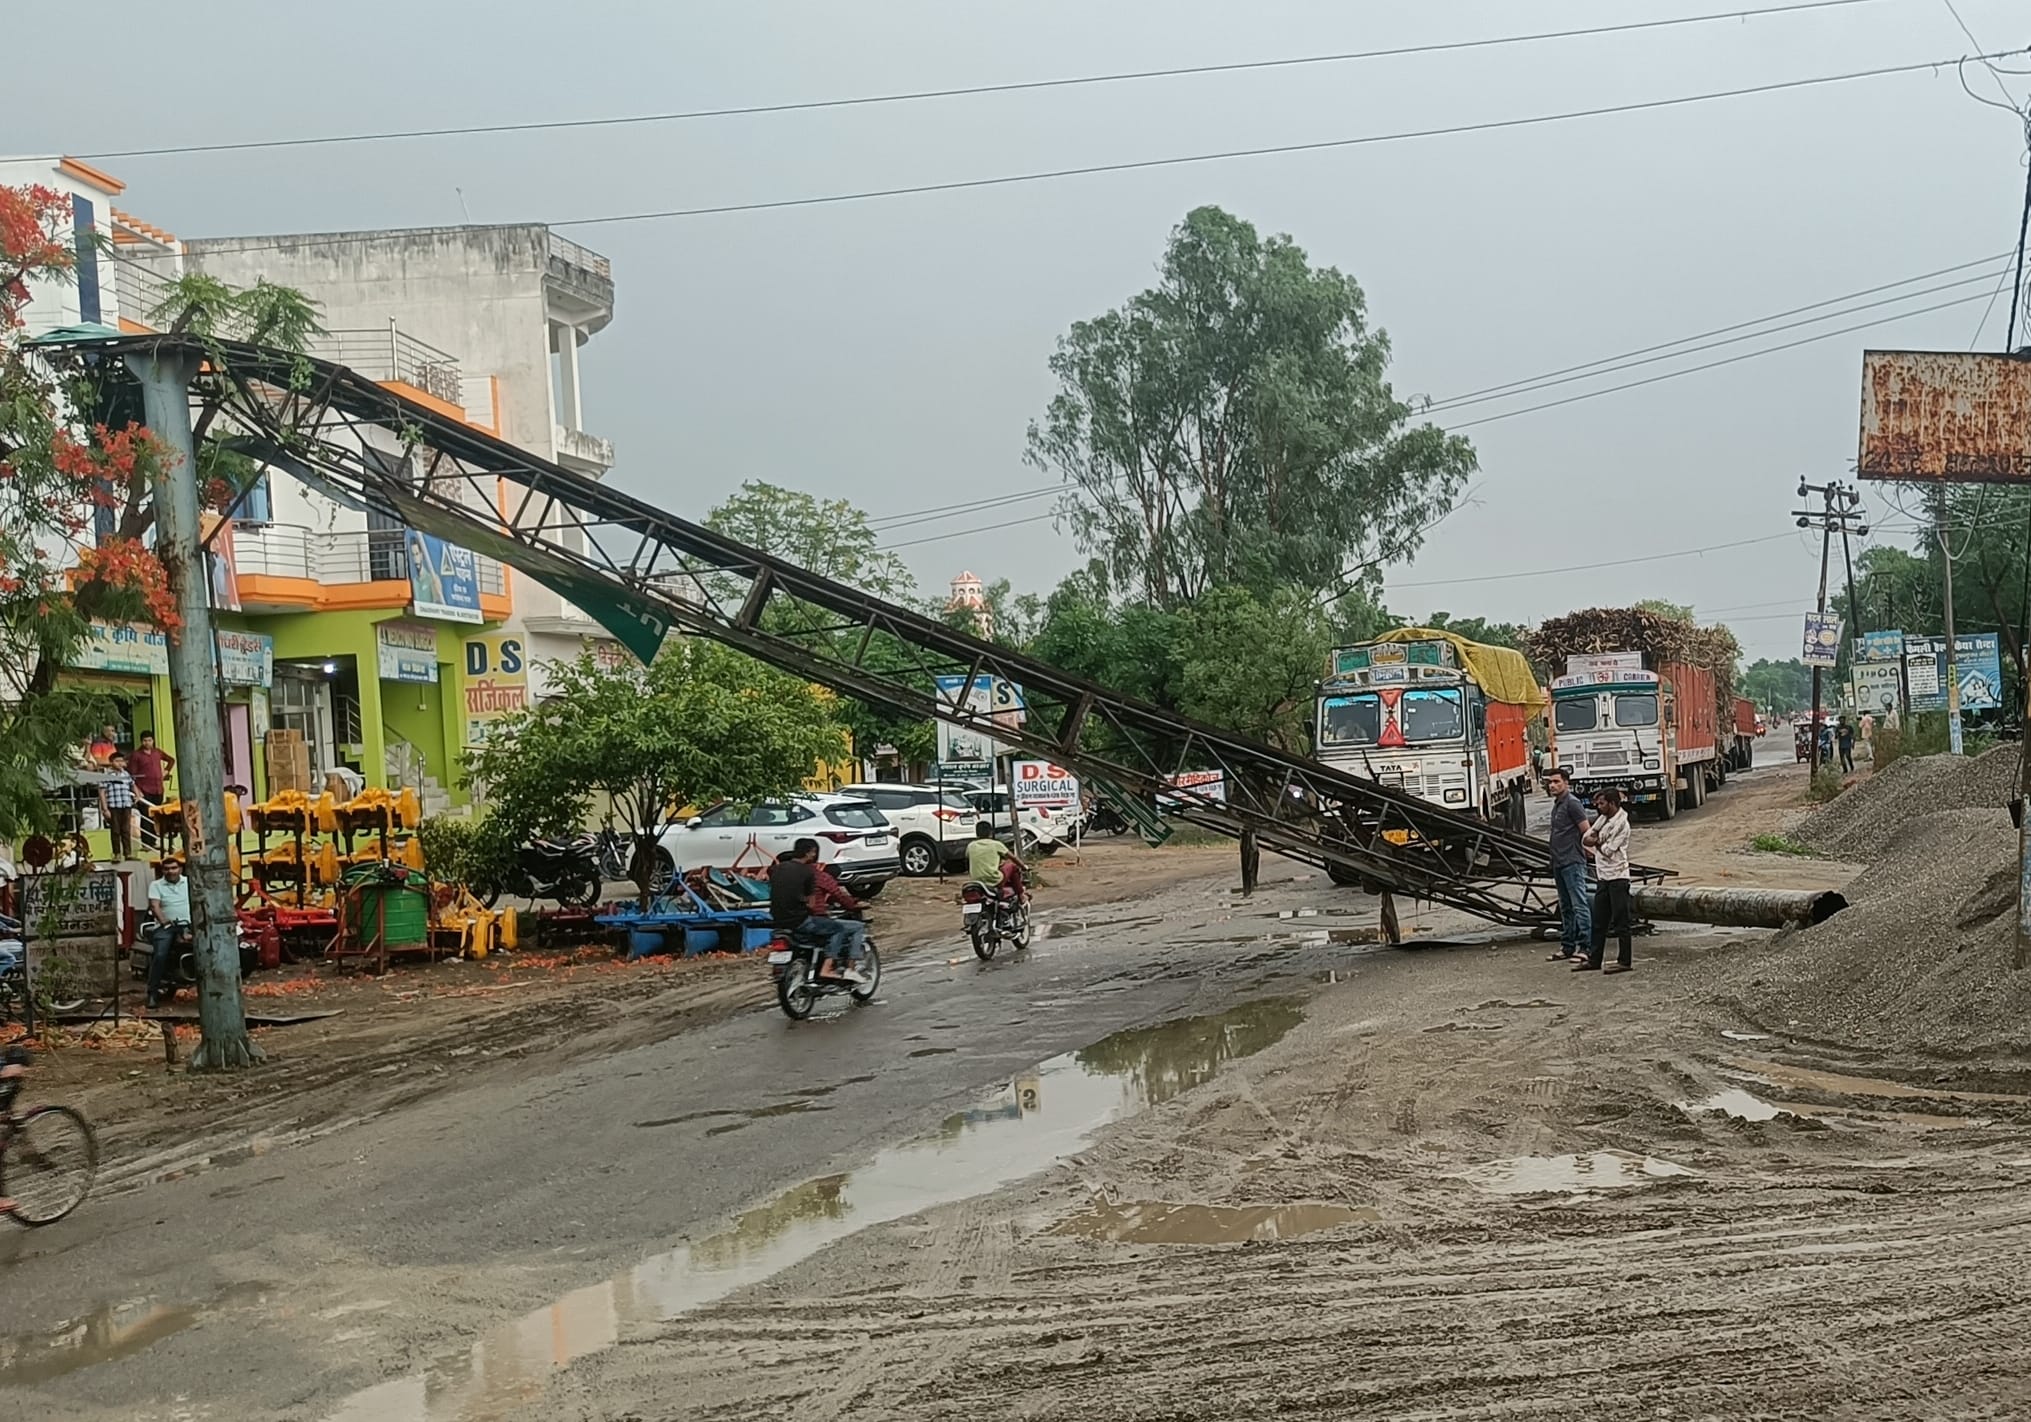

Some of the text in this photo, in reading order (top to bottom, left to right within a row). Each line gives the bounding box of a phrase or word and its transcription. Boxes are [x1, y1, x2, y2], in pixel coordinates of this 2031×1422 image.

[112, 624, 138, 643] कृषि
[1558, 676, 1584, 687] PUBLIC
[465, 679, 526, 713] सर्जिकल
[1017, 780, 1073, 793] SURGICAL
